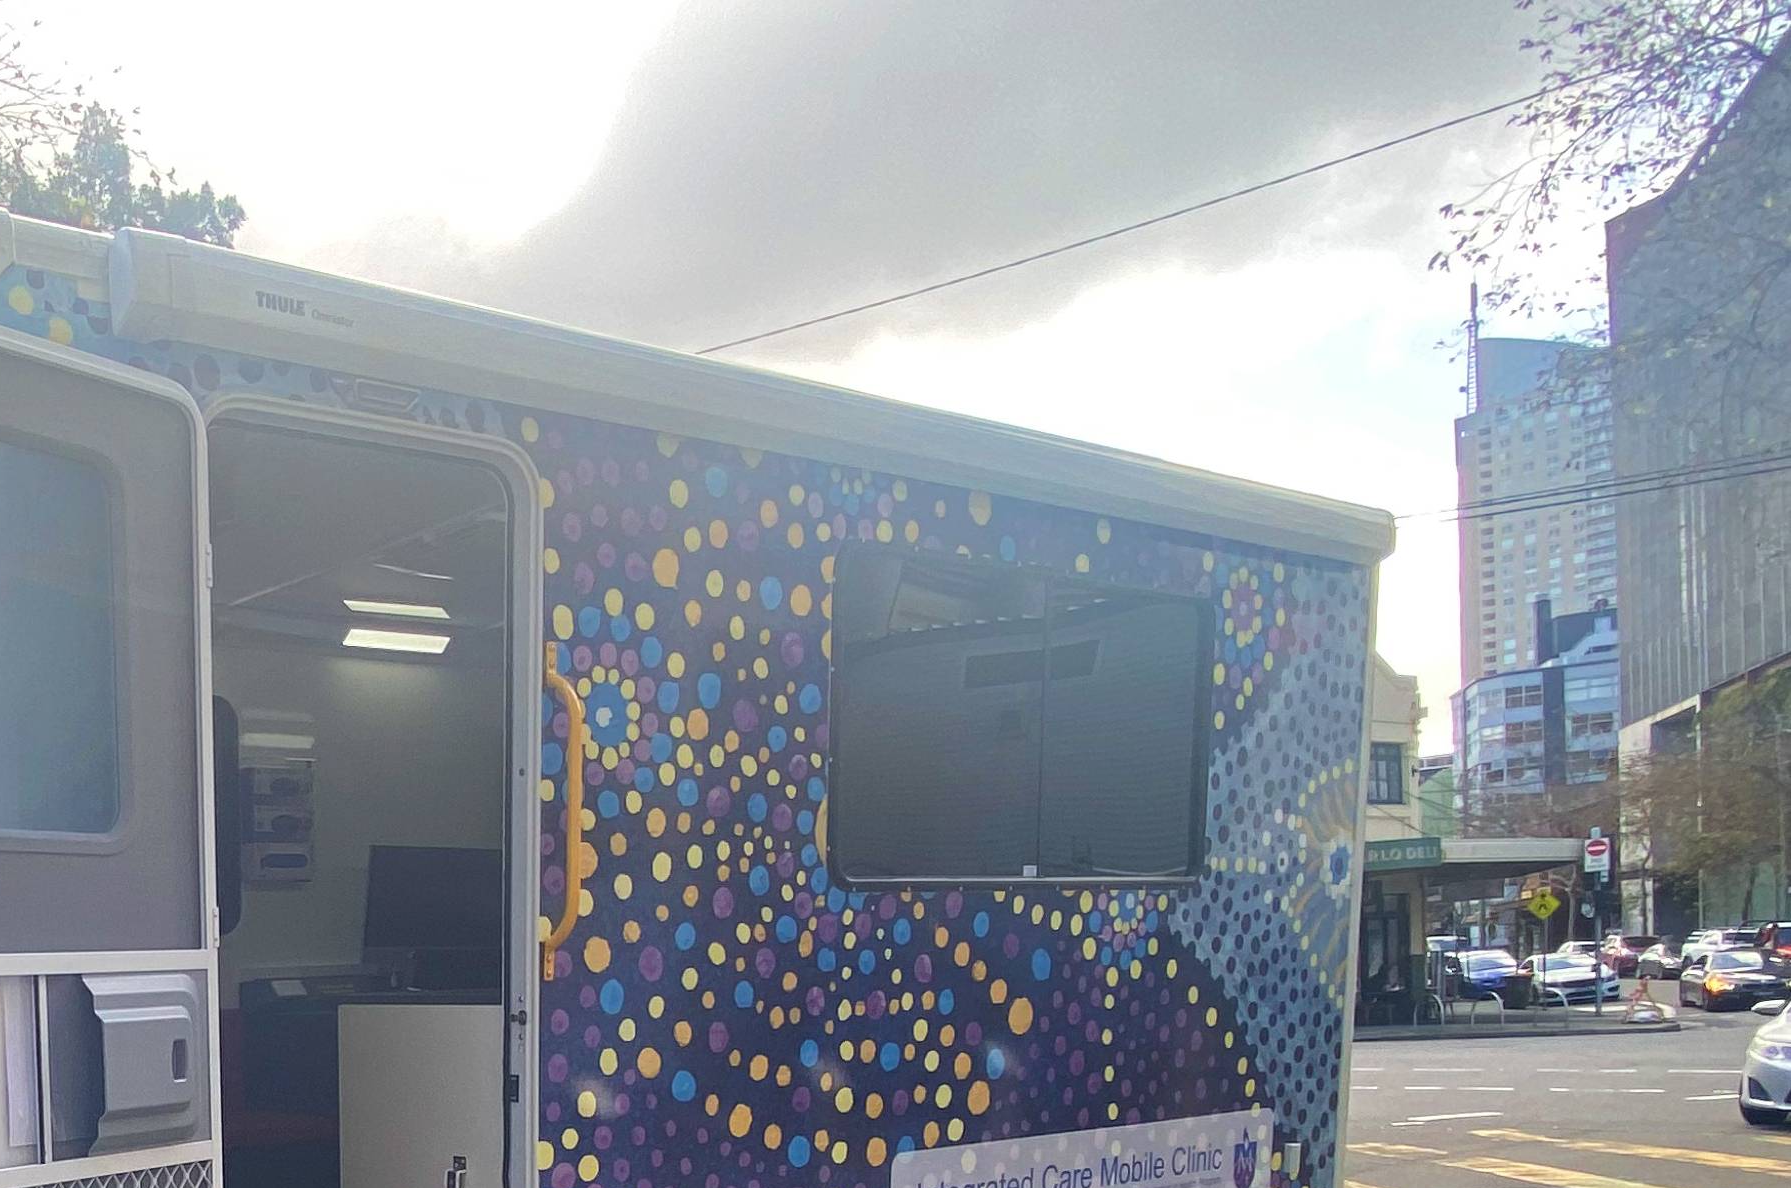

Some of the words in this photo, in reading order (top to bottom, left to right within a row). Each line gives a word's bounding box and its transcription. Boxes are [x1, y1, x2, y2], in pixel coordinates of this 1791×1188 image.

[255, 290, 305, 317] THULE
[1100, 1151, 1165, 1187] Mobile
[1172, 1144, 1223, 1177] Clinic
